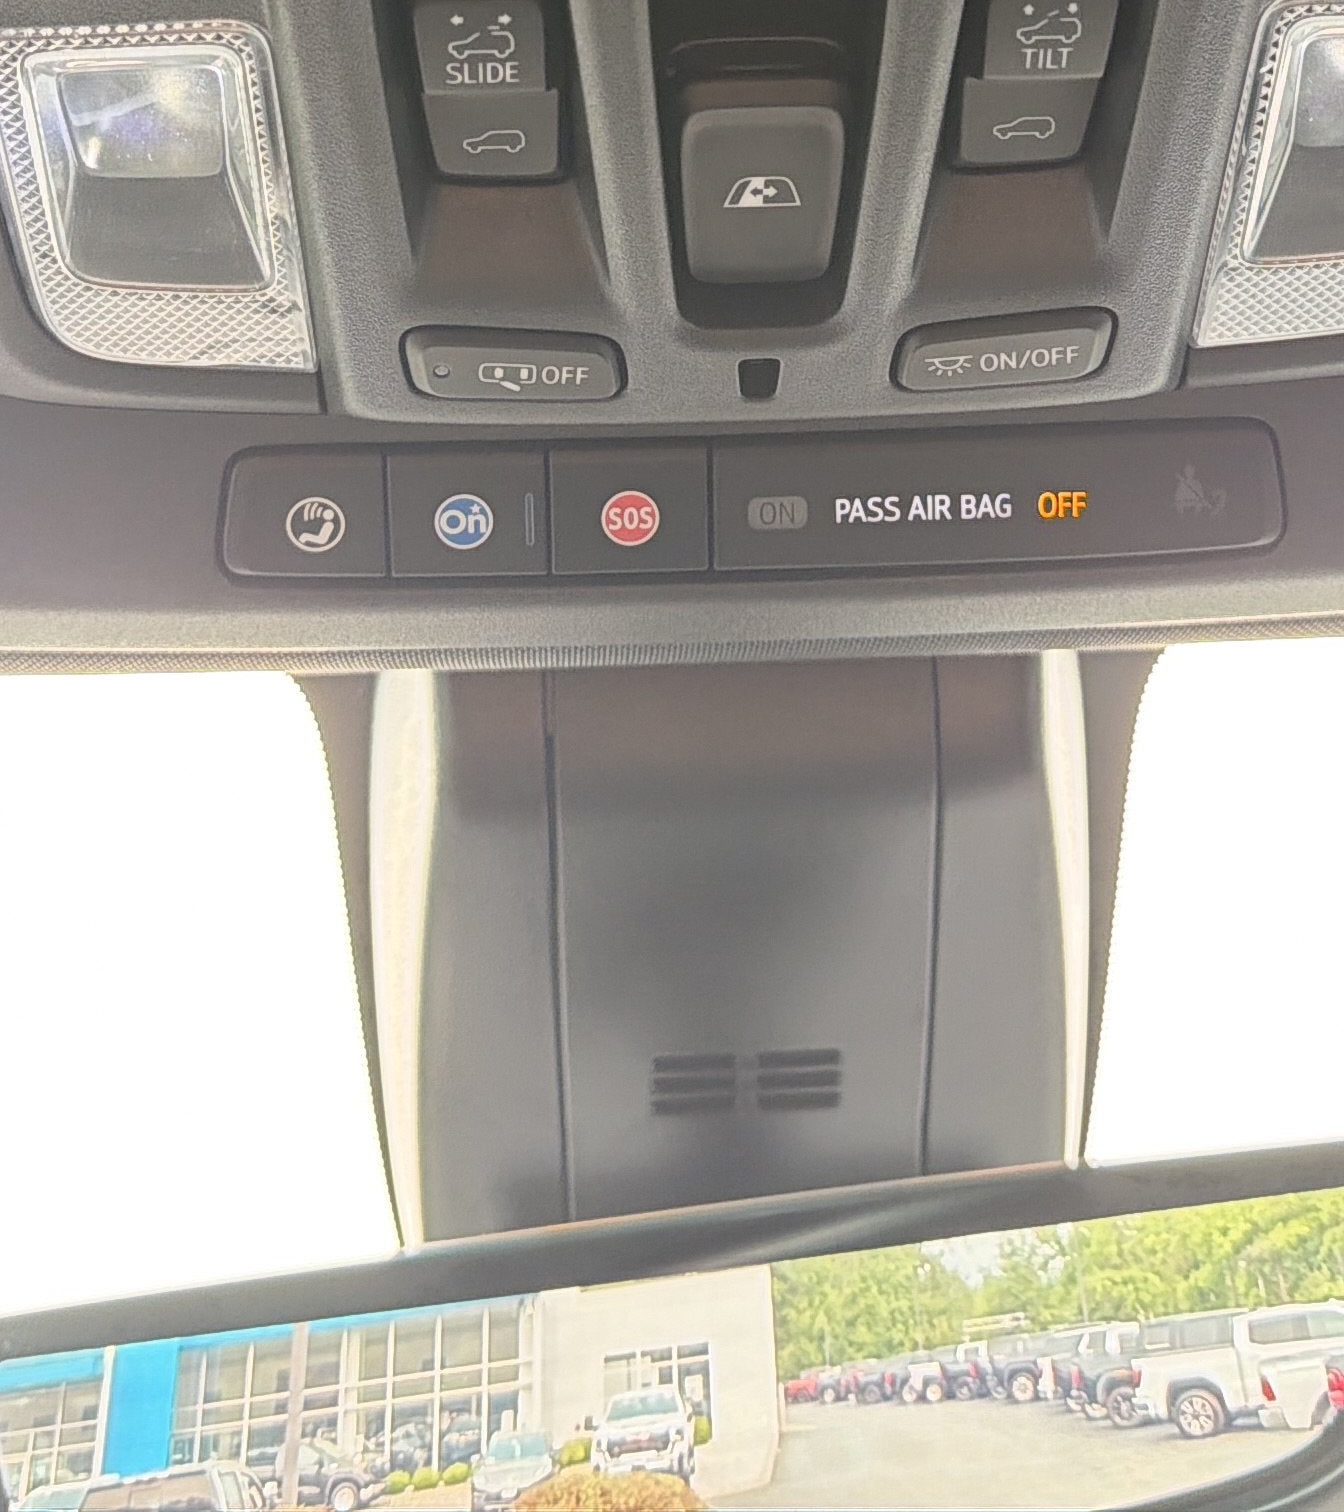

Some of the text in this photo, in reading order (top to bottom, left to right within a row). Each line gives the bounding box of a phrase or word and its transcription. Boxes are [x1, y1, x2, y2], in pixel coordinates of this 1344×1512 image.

[1020, 47, 1072, 71] TILT
[444, 61, 520, 85] SLIDE
[979, 345, 1081, 373] ON/OFF
[541, 365, 591, 385] OFF
[758, 501, 797, 527] ON
[834, 492, 1013, 524] PASS AIR BAG
[1036, 490, 1088, 520] OFF
[607, 506, 654, 532] SOS
